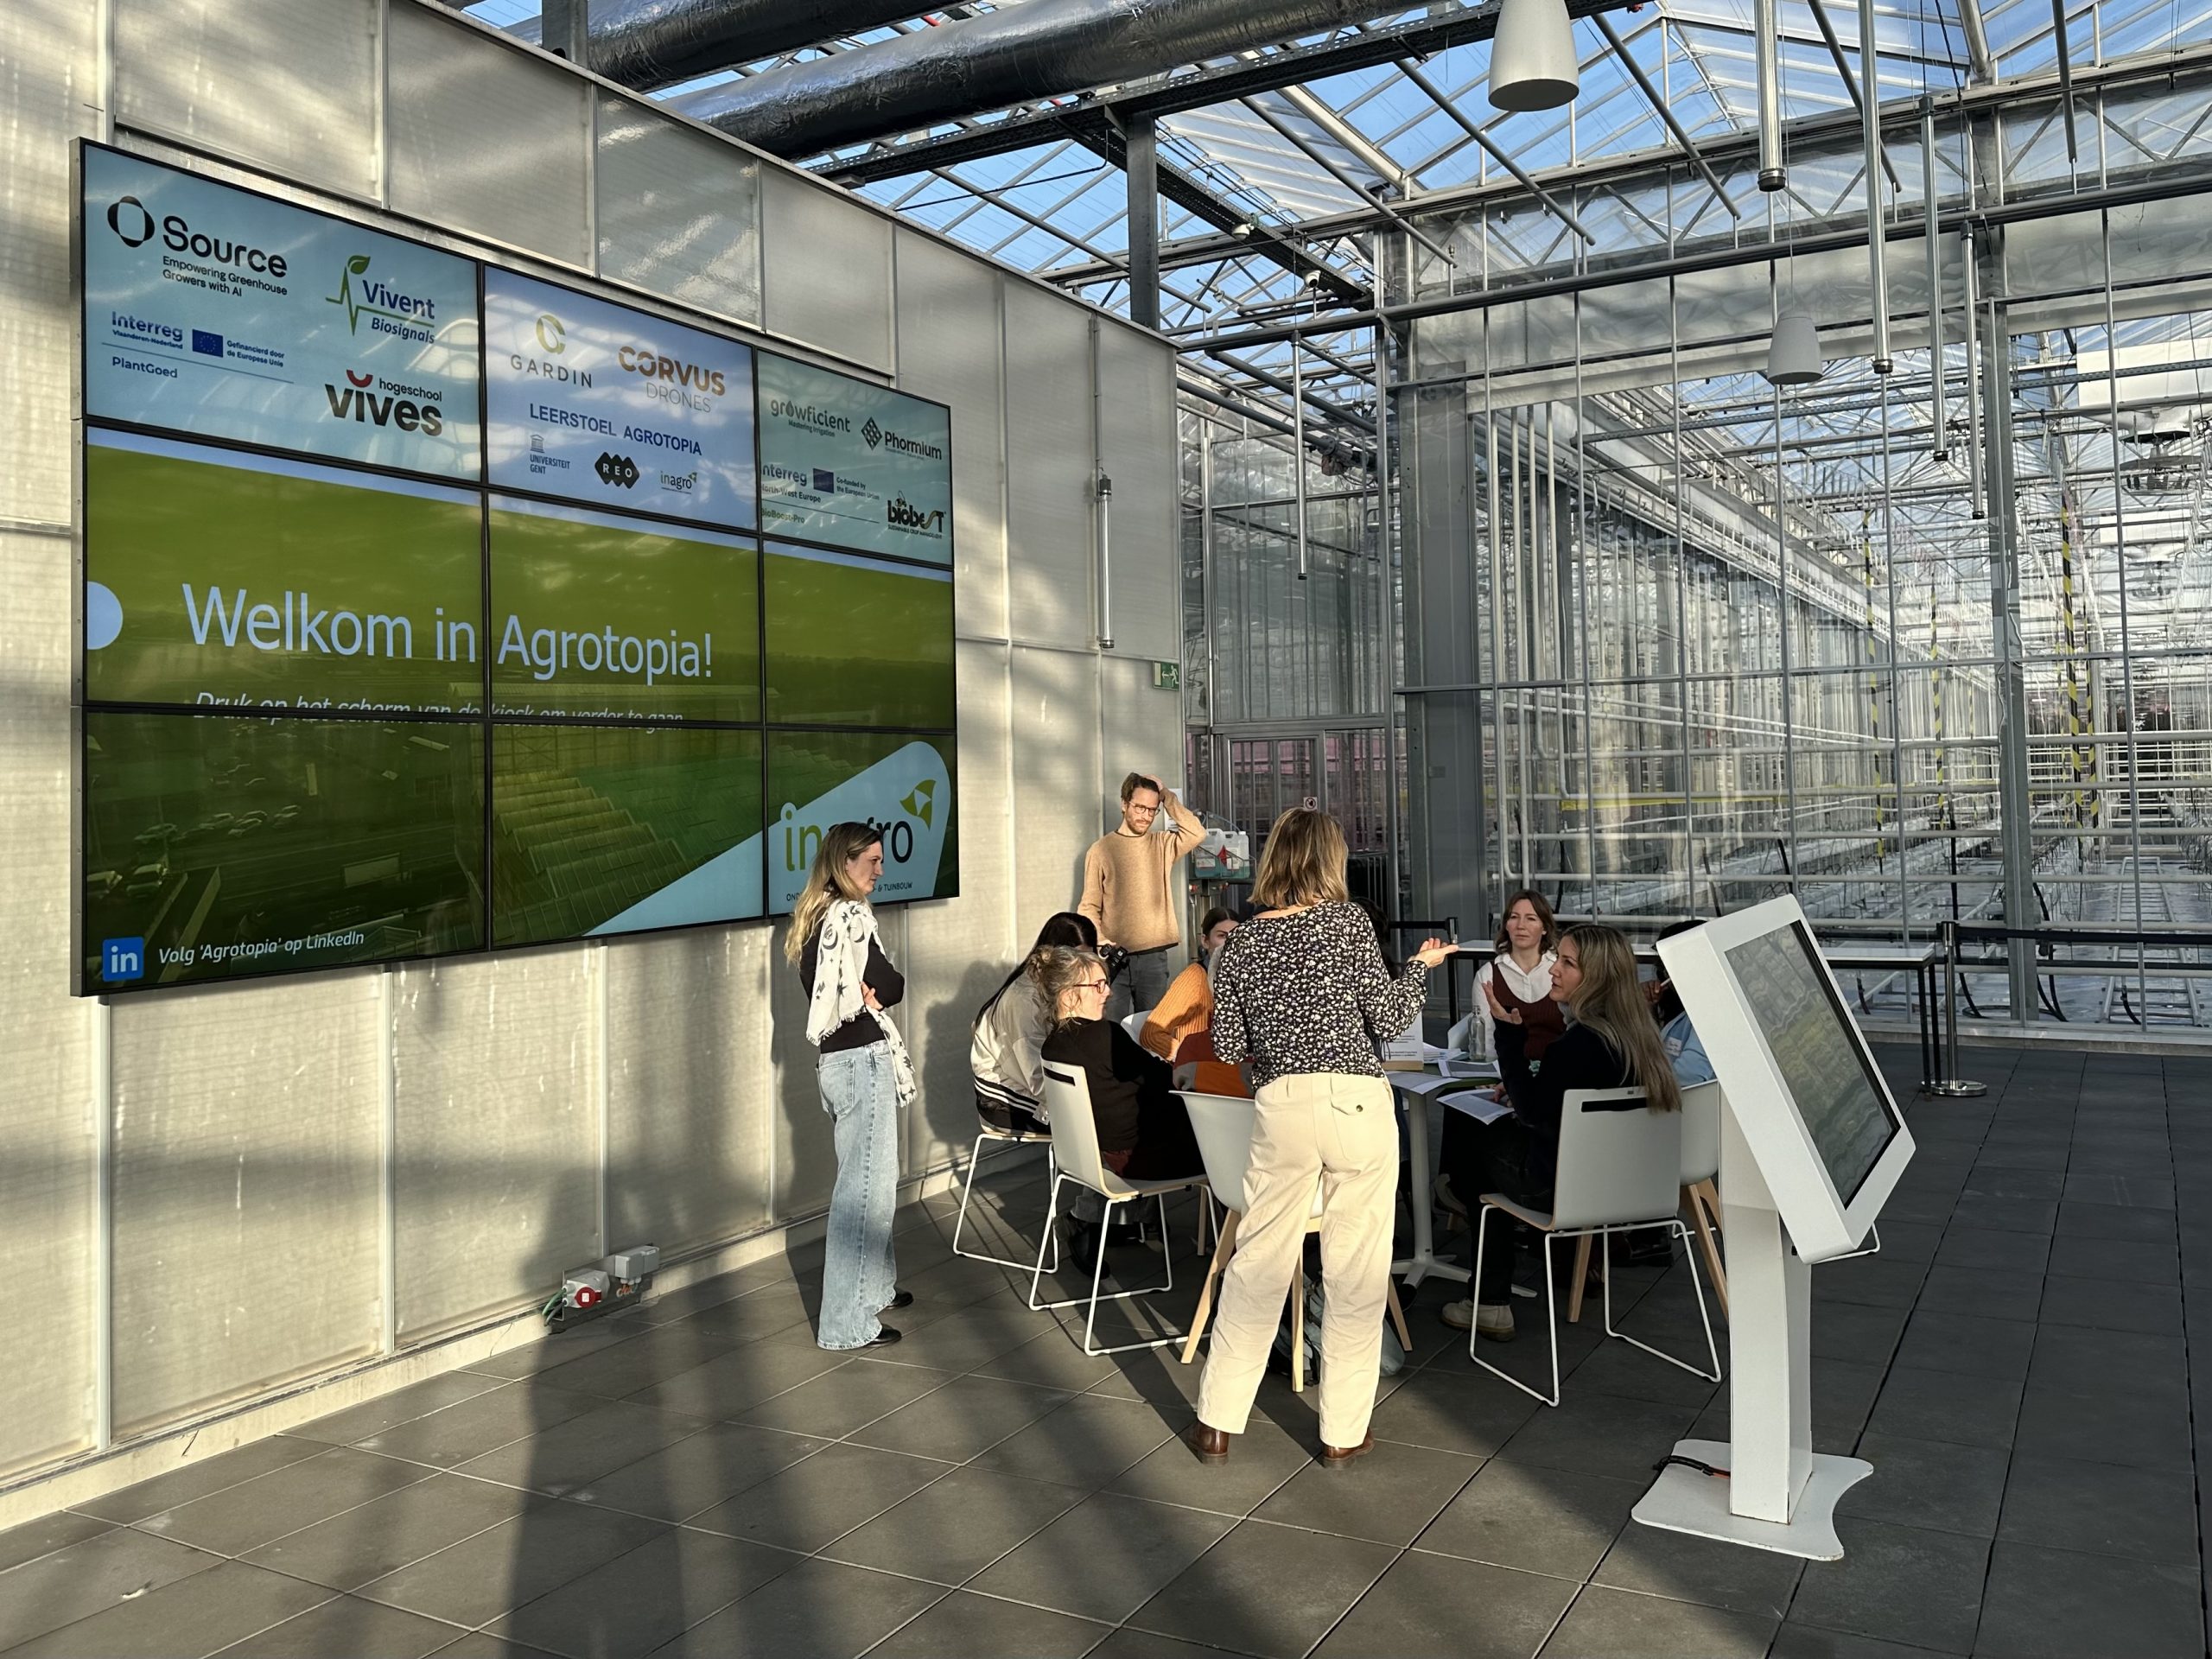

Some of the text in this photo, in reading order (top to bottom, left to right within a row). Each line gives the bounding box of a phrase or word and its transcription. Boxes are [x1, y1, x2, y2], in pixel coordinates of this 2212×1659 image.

[163, 215, 288, 278] Source
[162, 270, 242, 297] Growers with AI
[163, 256, 288, 296] Empowering Greenhouse
[362, 279, 435, 320] Vivent
[112, 311, 183, 342] Interreg
[372, 317, 435, 344] Biosignals
[112, 357, 178, 378] PlantGoed
[237, 351, 268, 364] Europese
[511, 354, 592, 389] GARDIN
[619, 346, 726, 397] CORVUS
[379, 378, 442, 402] hogeschool
[645, 382, 712, 413] DRONES
[325, 383, 442, 436] vives
[530, 404, 702, 456] LEERSTOEL AGROTOPIA
[885, 431, 942, 461] Phormium
[530, 454, 570, 469] UNIVERSITEIT
[530, 464, 546, 474] GENT
[762, 464, 808, 486] nterreg
[660, 470, 692, 490] inagro
[799, 492, 822, 504] Europe
[182, 583, 712, 686] Welkom in Agrotopia!
[884, 881, 913, 892] TUINBOUW
[158, 946, 194, 966] Volg
[284, 938, 302, 954] op
[306, 931, 365, 949] LinkedIn
